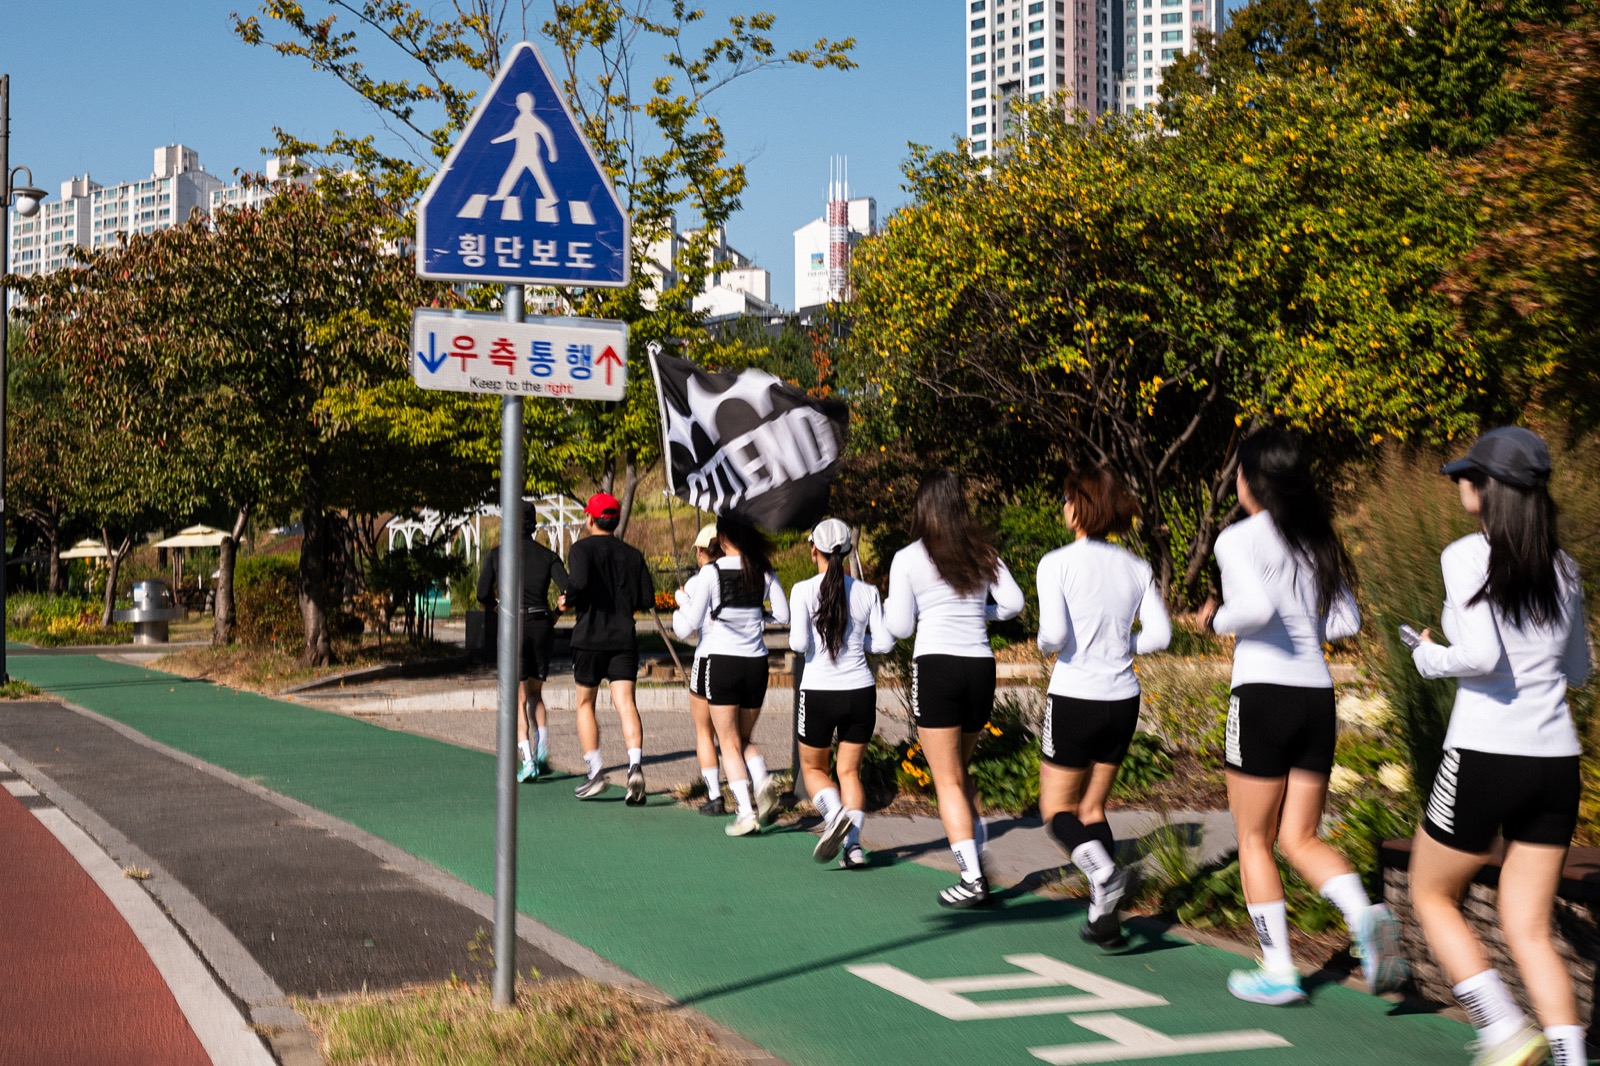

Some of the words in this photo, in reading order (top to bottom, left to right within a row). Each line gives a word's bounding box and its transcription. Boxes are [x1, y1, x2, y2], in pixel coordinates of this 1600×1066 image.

[457, 233, 597, 268] 횡단보도
[448, 335, 593, 380] 우측통행
[470, 376, 503, 391] Keep
[506, 379, 519, 391] to
[522, 379, 542, 393] the
[544, 382, 574, 396] right
[1426, 748, 1461, 835] FREEDOM
